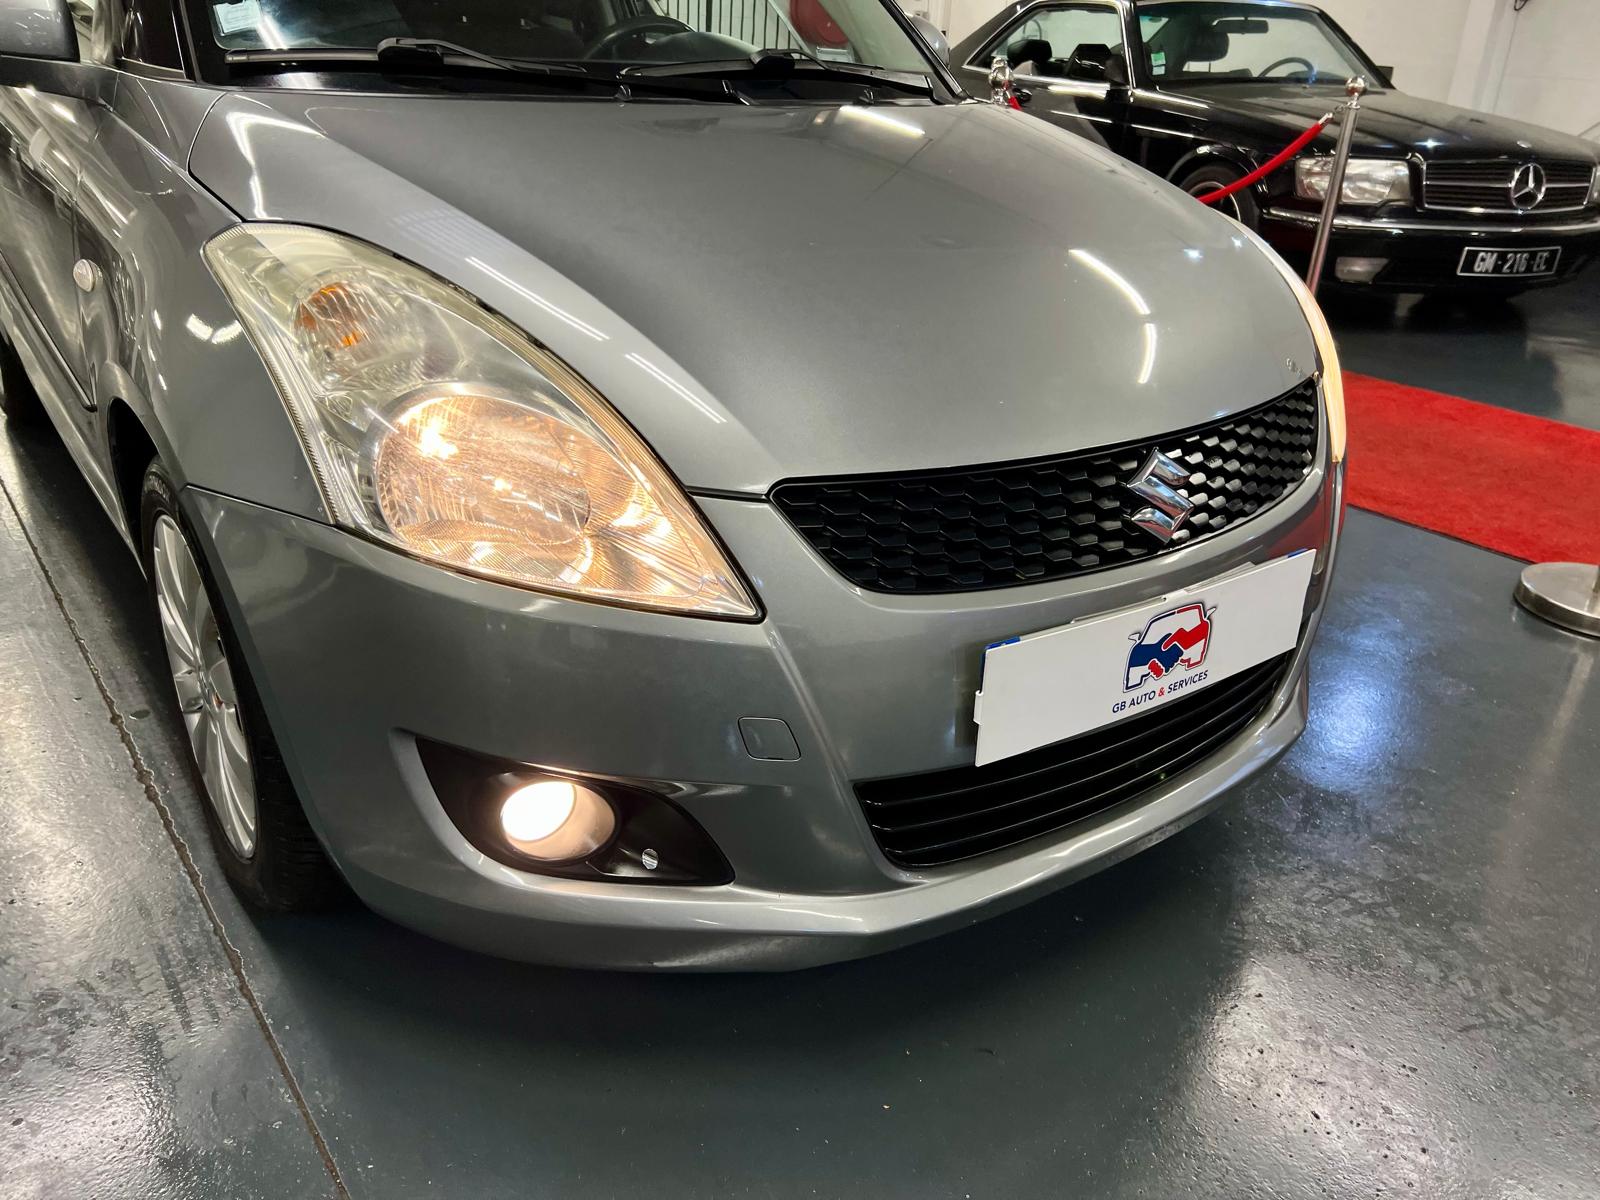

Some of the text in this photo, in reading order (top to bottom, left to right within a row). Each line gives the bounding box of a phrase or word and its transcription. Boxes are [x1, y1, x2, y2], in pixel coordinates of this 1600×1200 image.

[1112, 670, 1209, 714] GB AUTO & SERVICES
